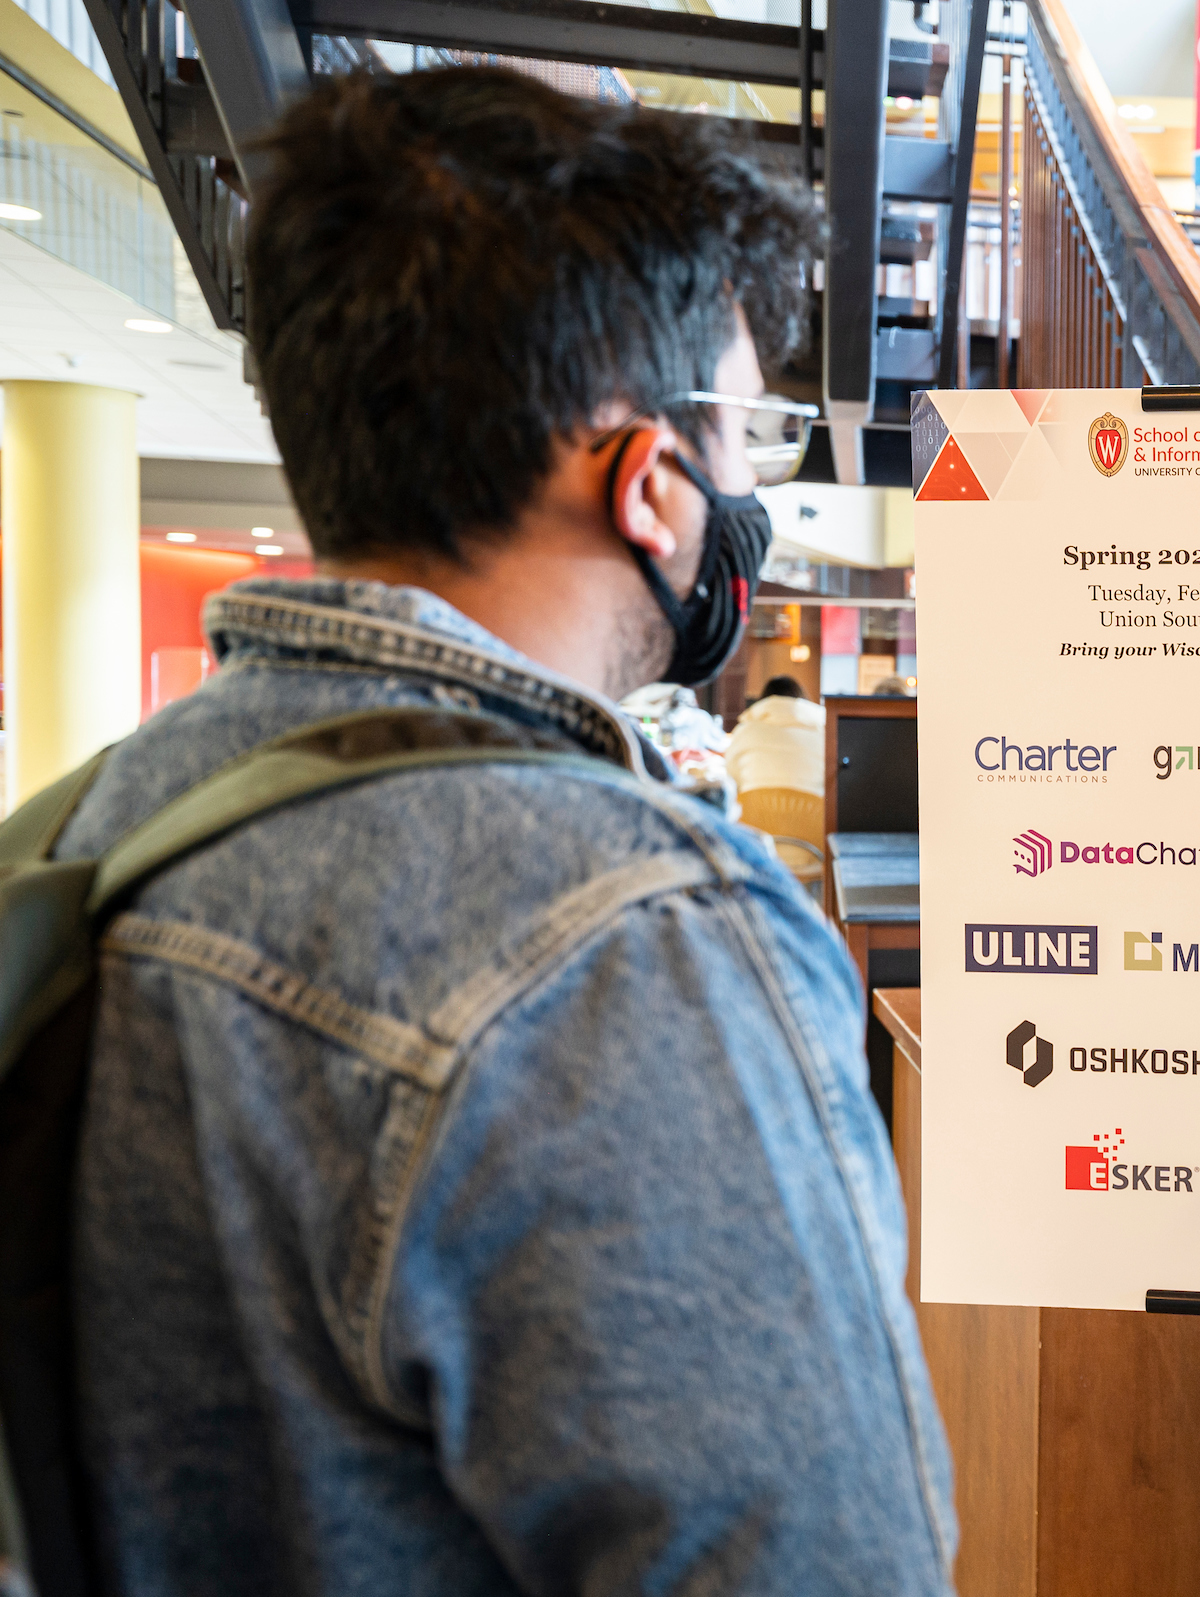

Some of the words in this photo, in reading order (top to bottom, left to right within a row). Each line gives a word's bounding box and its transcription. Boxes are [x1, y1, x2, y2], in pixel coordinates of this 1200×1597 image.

[1133, 426, 1188, 443] School
[1133, 446, 1147, 462] &
[1134, 467, 1193, 477] UNIVERSITY
[1063, 543, 1152, 570] Spring
[1087, 583, 1172, 606] Tuesday,
[1098, 609, 1157, 628] Union
[1058, 641, 1110, 660] Bring
[1113, 646, 1158, 660] your
[974, 735, 1118, 773] Charter
[977, 774, 1108, 784] COMMUNICATIONS
[971, 931, 1091, 969] ULINE
